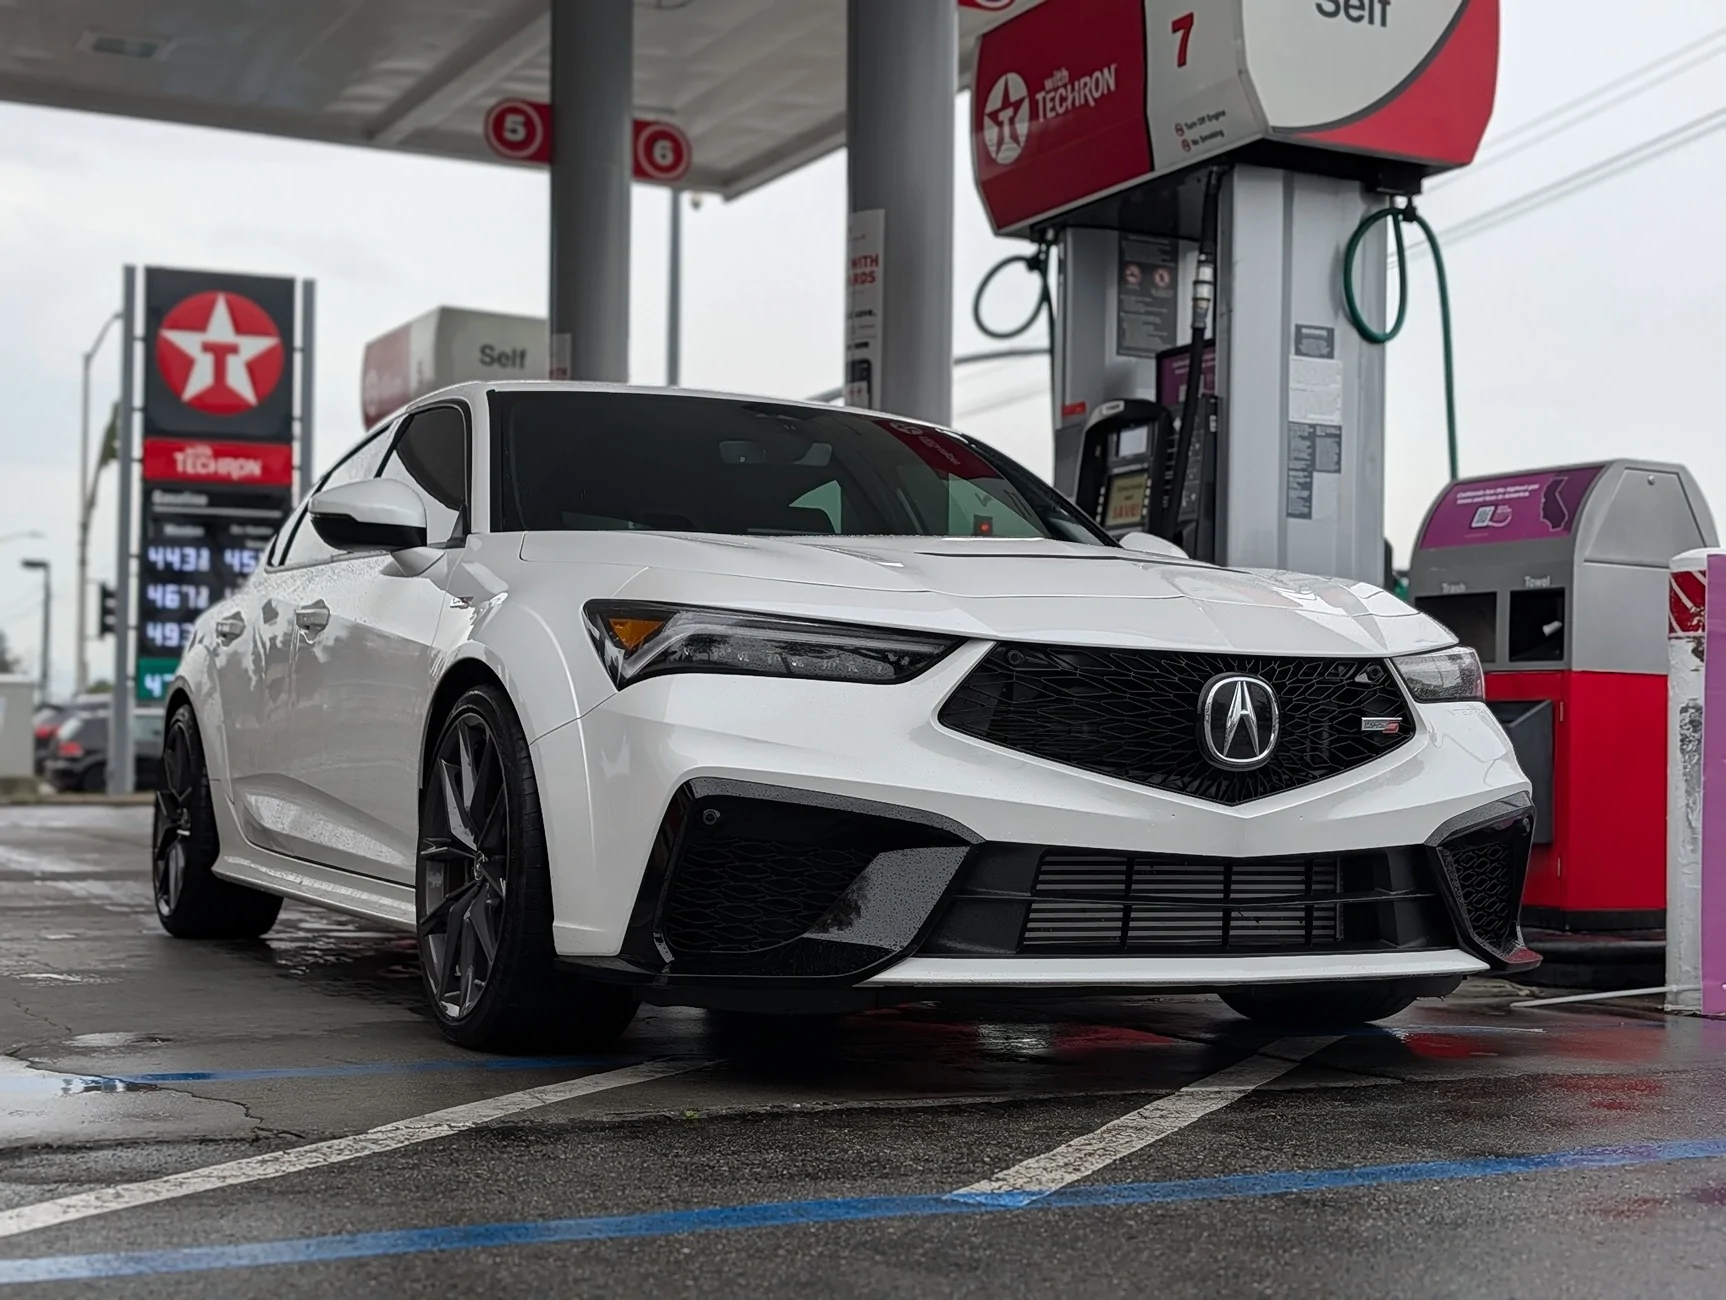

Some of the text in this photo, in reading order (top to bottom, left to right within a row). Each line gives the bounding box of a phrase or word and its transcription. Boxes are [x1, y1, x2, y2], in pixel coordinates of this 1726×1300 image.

[1315, 0, 1391, 27] Self
[1171, 12, 1194, 68] 7
[1035, 62, 1118, 122] TECHRON
[1044, 66, 1069, 91] with
[503, 114, 527, 142] 5
[652, 138, 674, 167] 6
[478, 343, 527, 370] Self
